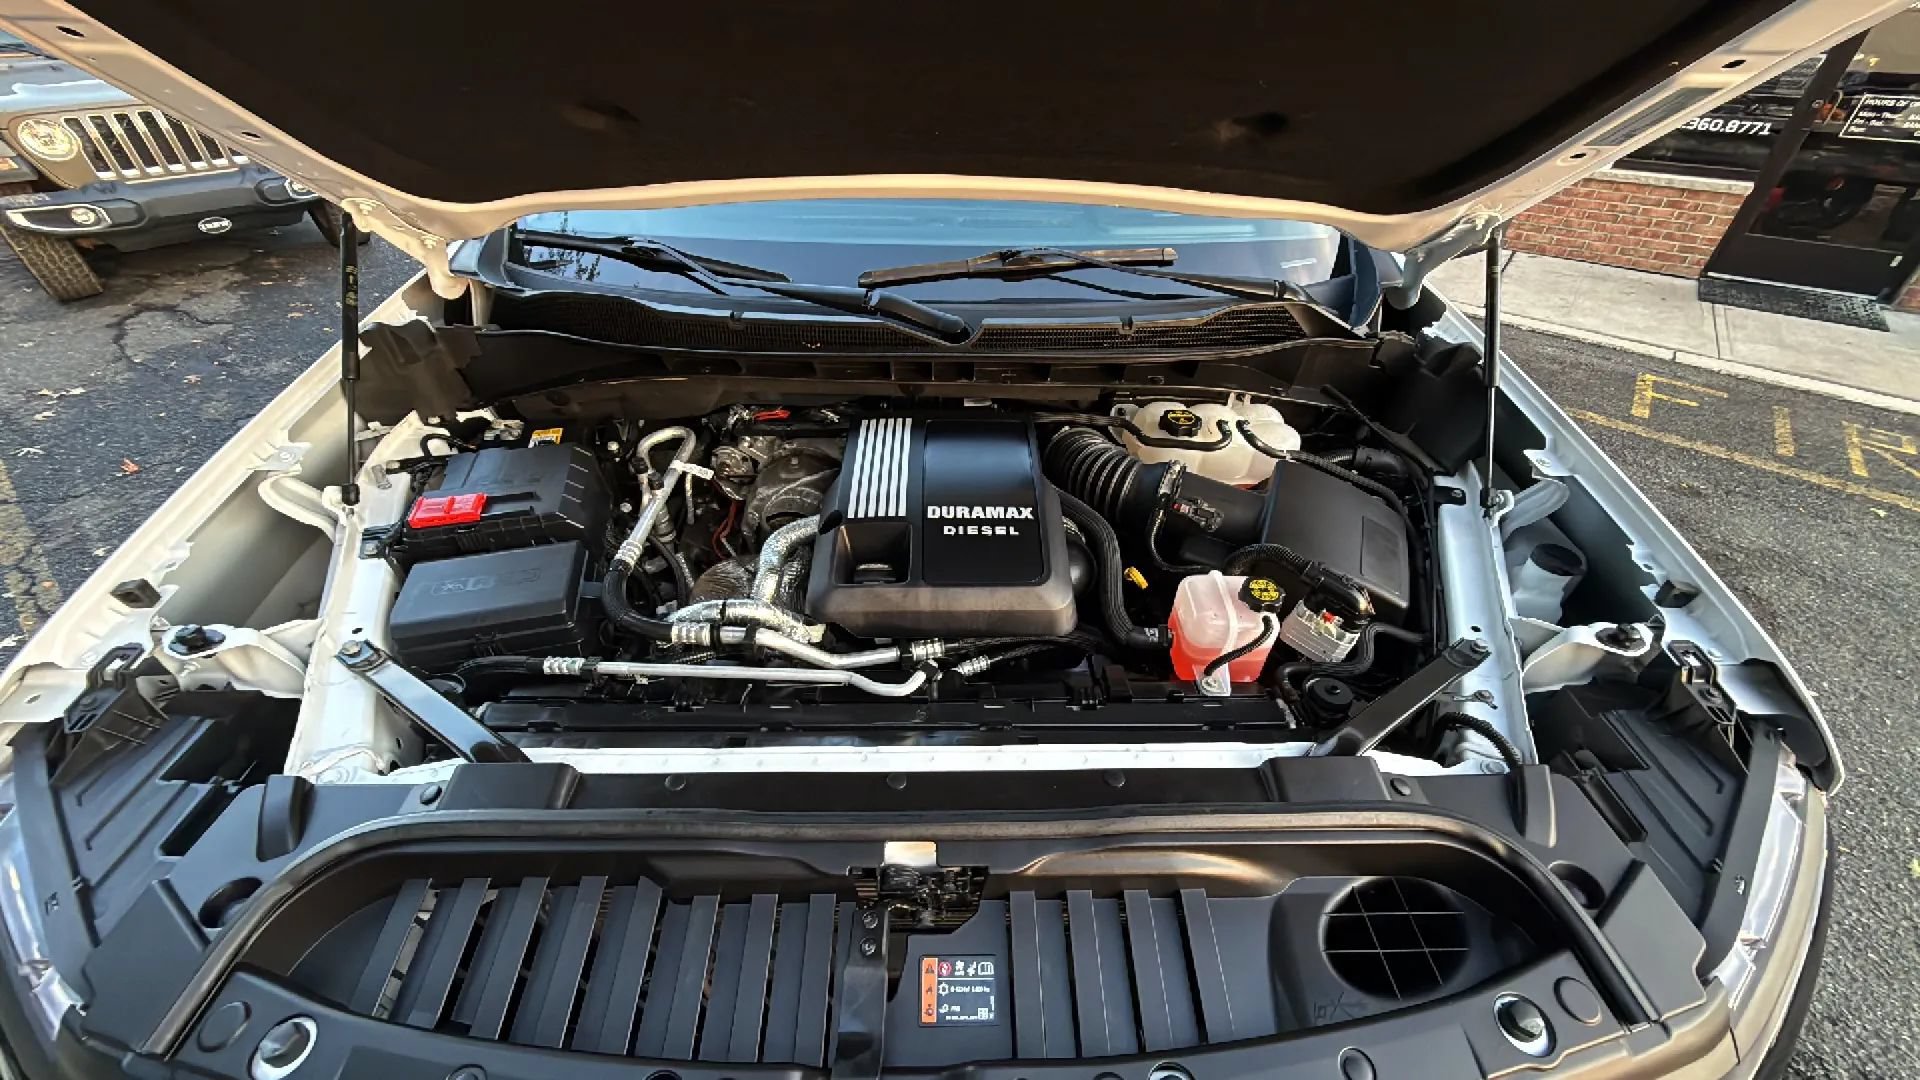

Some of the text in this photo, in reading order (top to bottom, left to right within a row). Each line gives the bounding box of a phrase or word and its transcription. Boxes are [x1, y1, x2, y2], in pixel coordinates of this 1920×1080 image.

[1864, 98, 1897, 107] HOURS
[927, 505, 1034, 520] DURAMAX
[943, 525, 1020, 536] DIESEL
